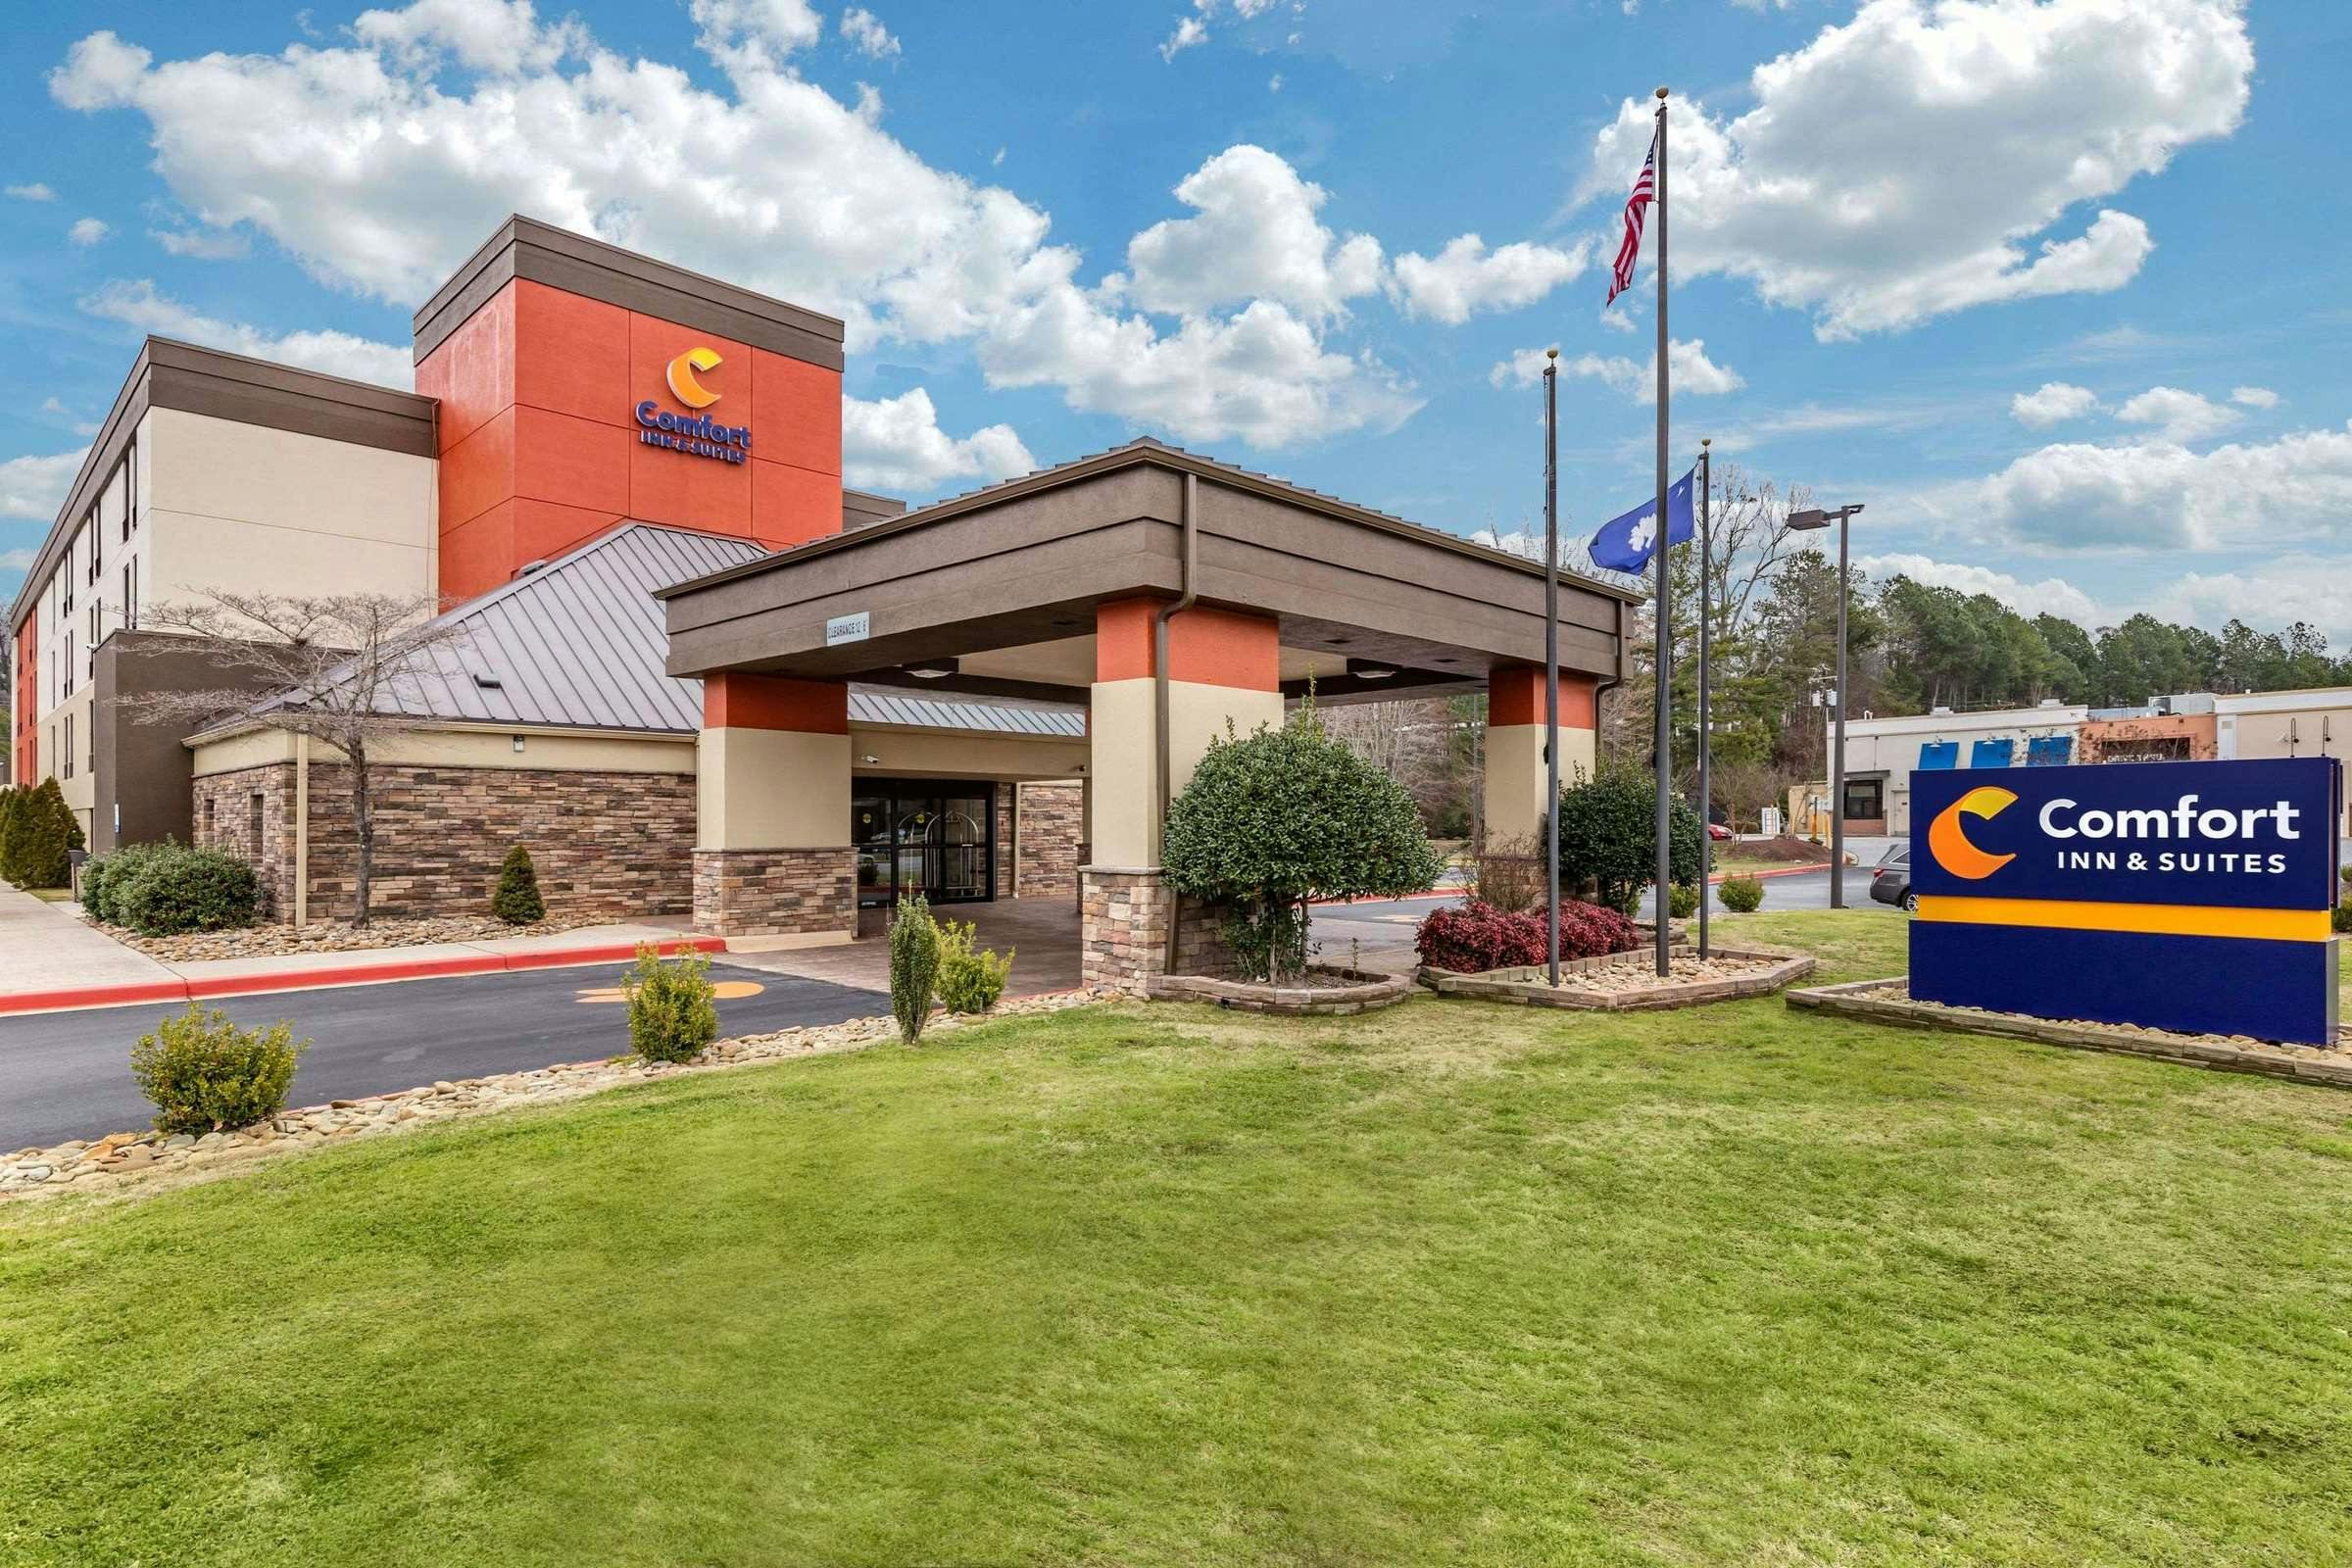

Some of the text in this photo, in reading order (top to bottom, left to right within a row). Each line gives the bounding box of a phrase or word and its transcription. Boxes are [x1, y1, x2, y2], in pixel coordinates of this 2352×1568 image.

[635, 400, 752, 449] Comfort
[640, 430, 673, 448] INN
[690, 441, 747, 465] SUITES
[2038, 794, 2301, 840] Comfort
[2057, 851, 2287, 874] INN & SUITES
